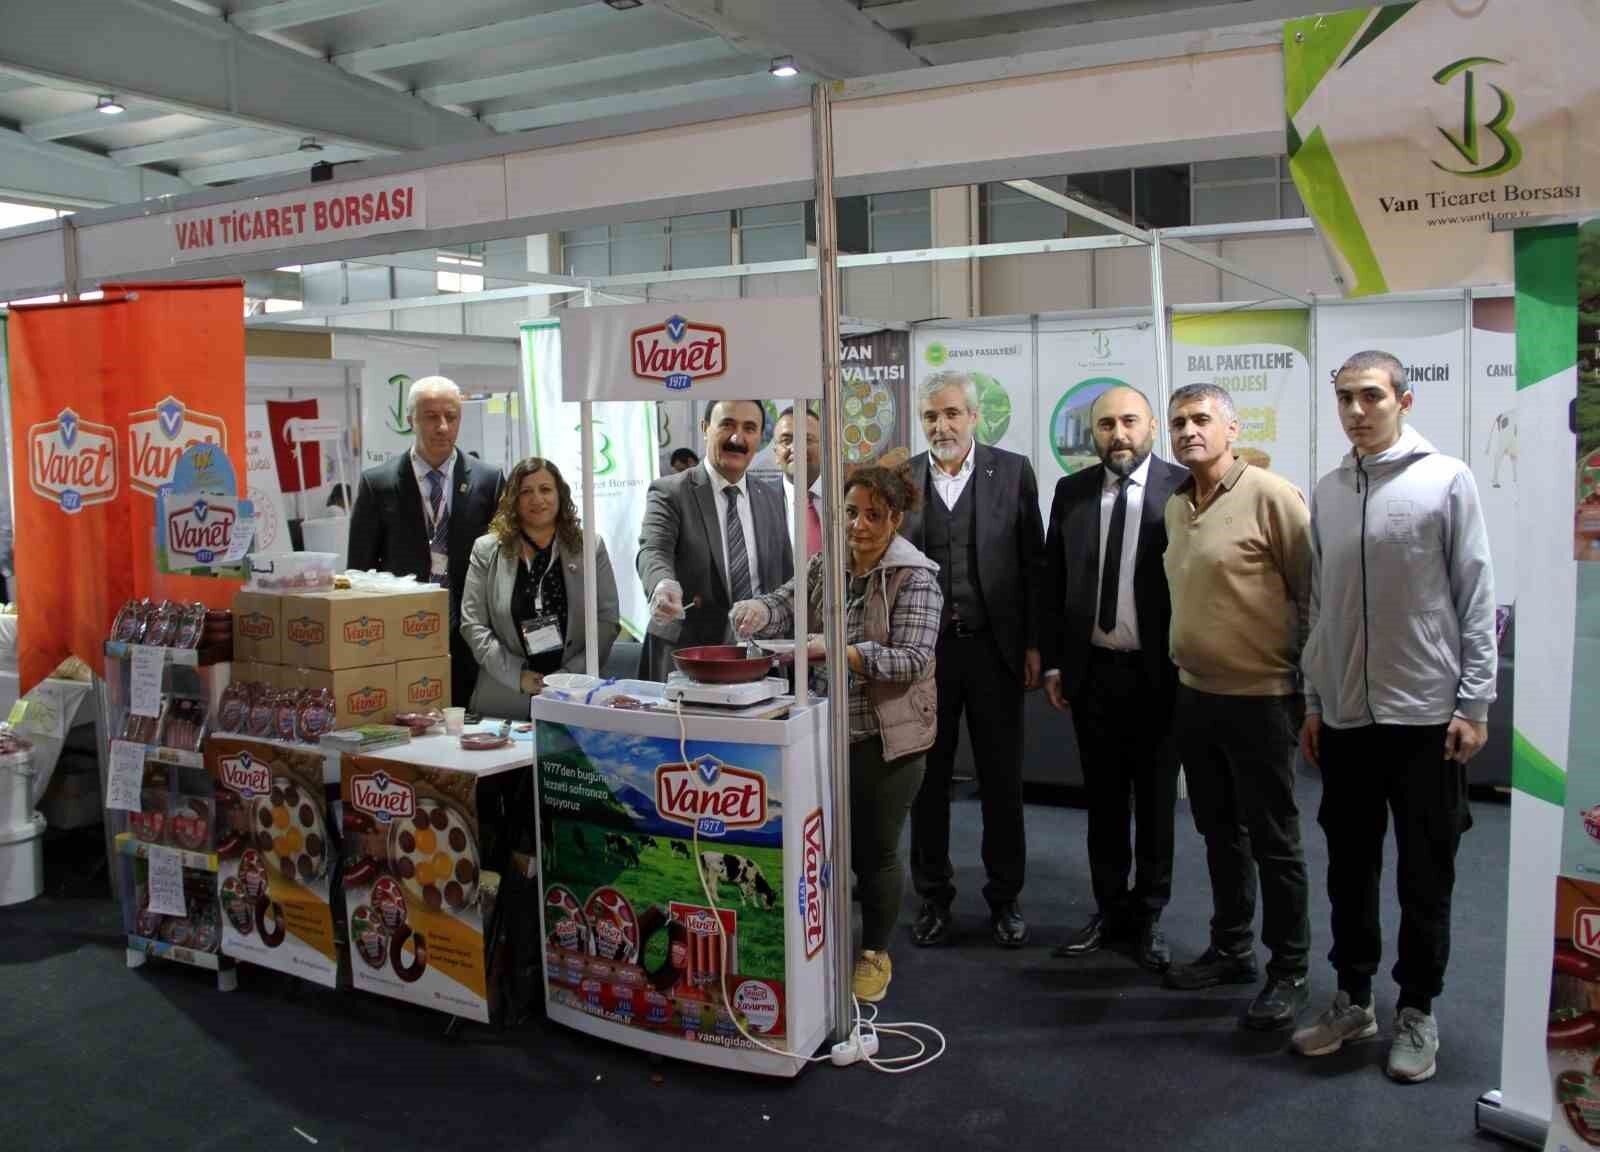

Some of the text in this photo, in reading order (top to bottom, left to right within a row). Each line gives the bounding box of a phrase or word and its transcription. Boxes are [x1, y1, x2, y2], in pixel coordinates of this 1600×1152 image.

[1379, 183, 1582, 213] Van Ticaret Borsası
[176, 186, 414, 250] VAN TİCARET BORSASI
[636, 336, 720, 373] Vanet
[839, 344, 872, 361] VAN
[1187, 351, 1294, 372] BAL PAKETLEME
[668, 375, 688, 387] 1977
[841, 363, 905, 382] VALTISI
[1486, 364, 1515, 377] CANL
[36, 439, 112, 488] Vanet
[173, 517, 233, 549] Vanet
[223, 762, 267, 791] Vanet
[356, 783, 410, 813] Vanet
[662, 776, 759, 819] Vanet
[699, 820, 721, 834] 1977
[805, 818, 822, 945] Vanet
